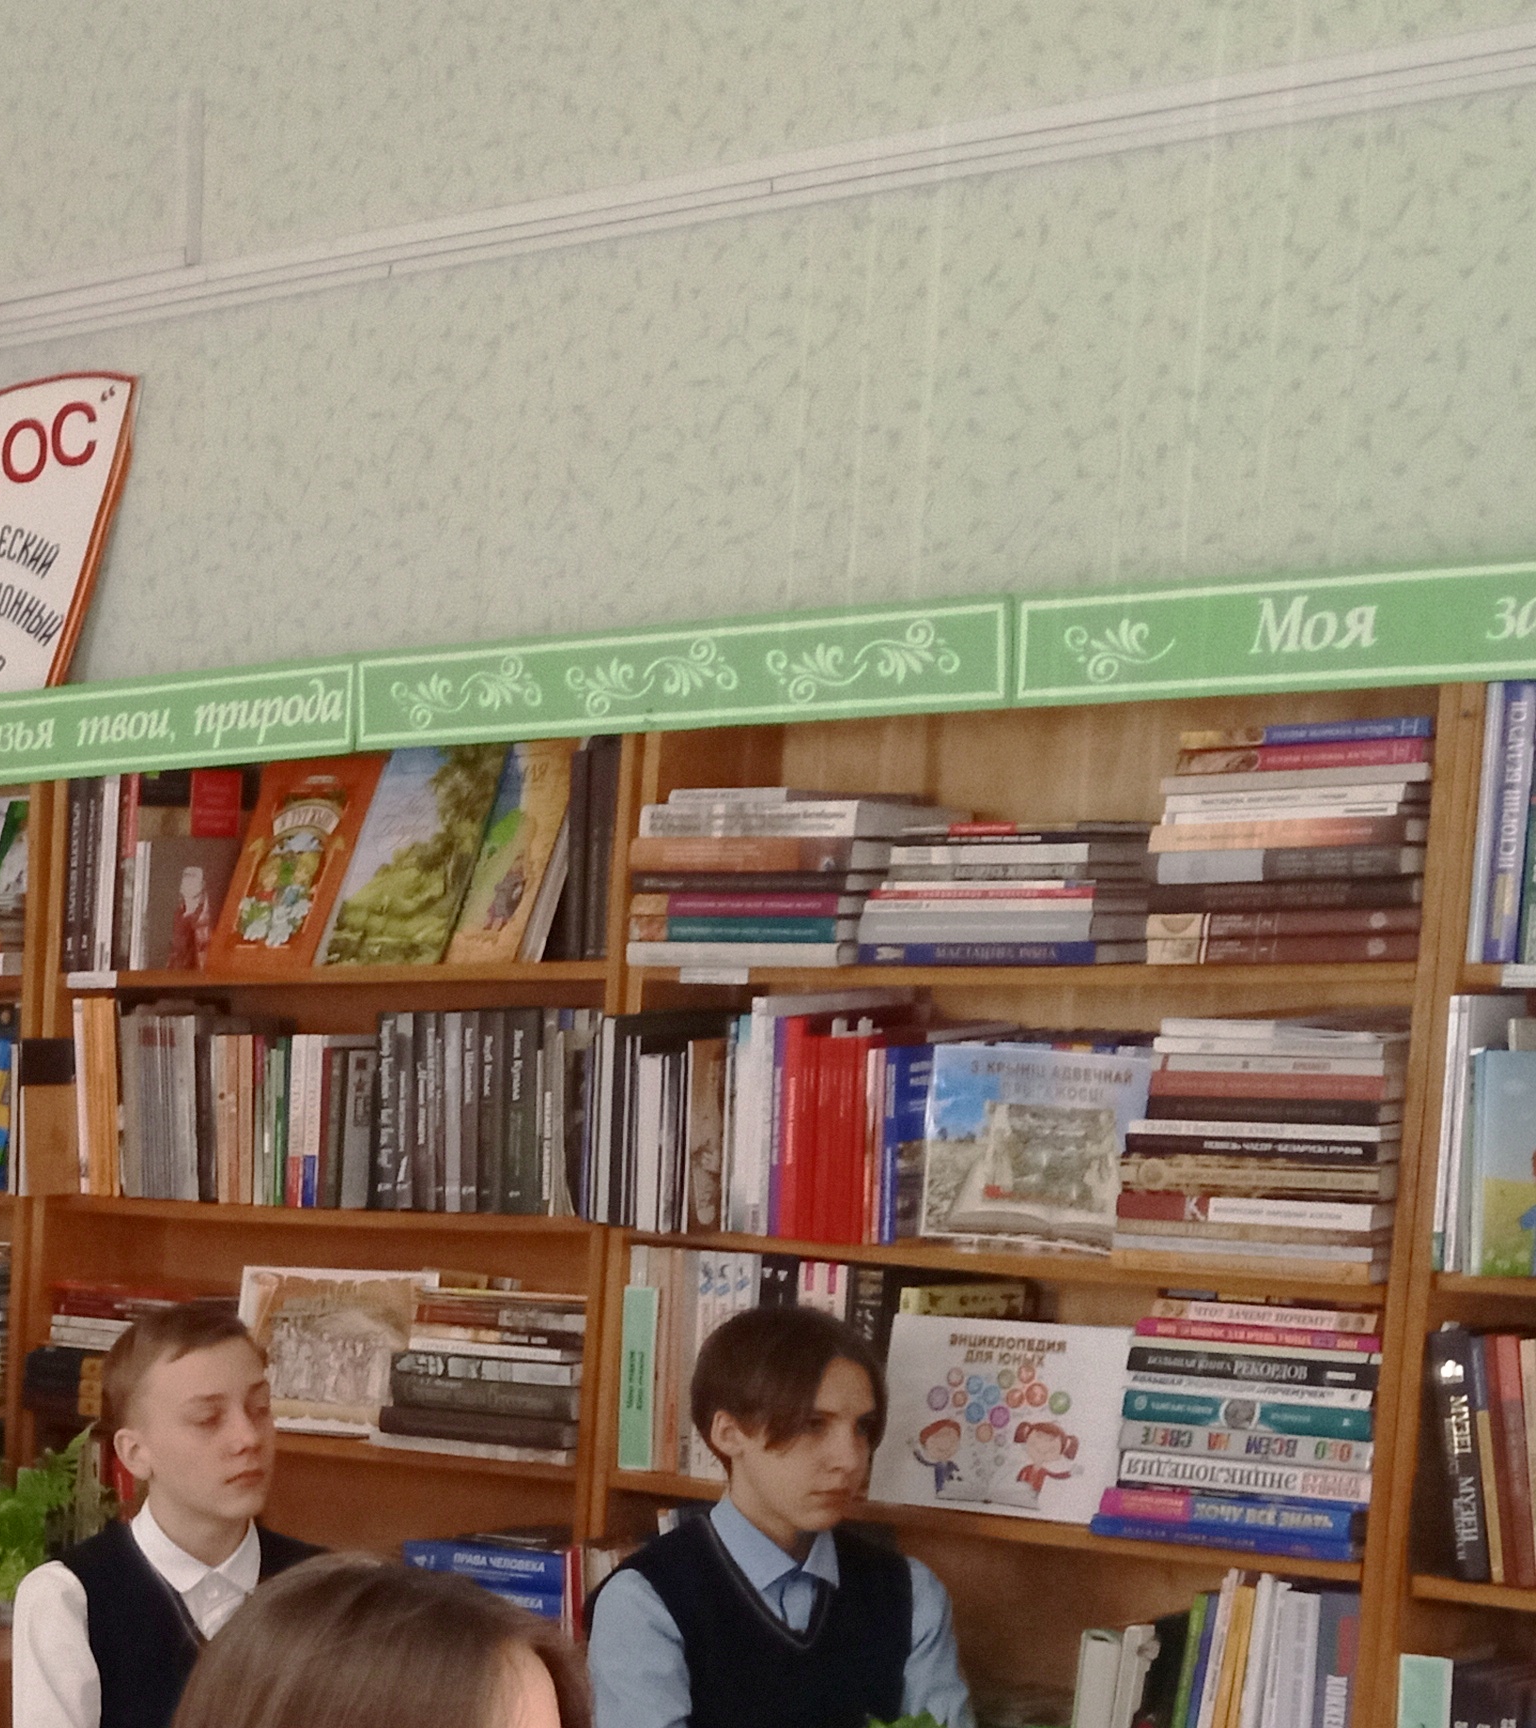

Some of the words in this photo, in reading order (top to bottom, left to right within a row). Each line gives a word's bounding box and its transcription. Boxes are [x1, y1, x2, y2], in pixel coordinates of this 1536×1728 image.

[1250, 595, 1378, 656] Моя
[193, 679, 344, 750] природа
[949, 1332, 1067, 1354] ЭНЦИКЛОПЕДИЯ
[964, 1348, 994, 1364] ДЛЯ
[998, 1351, 1046, 1367] ЮНЫХ
[1233, 1359, 1308, 1380] РЕКОРДОВ
[1126, 1457, 1298, 1491] ЭНЦИКЛОПЕДИЯ
[452, 1552, 488, 1566] ПРАВА
[489, 1554, 545, 1573] ЧЕЛОВЕКА
